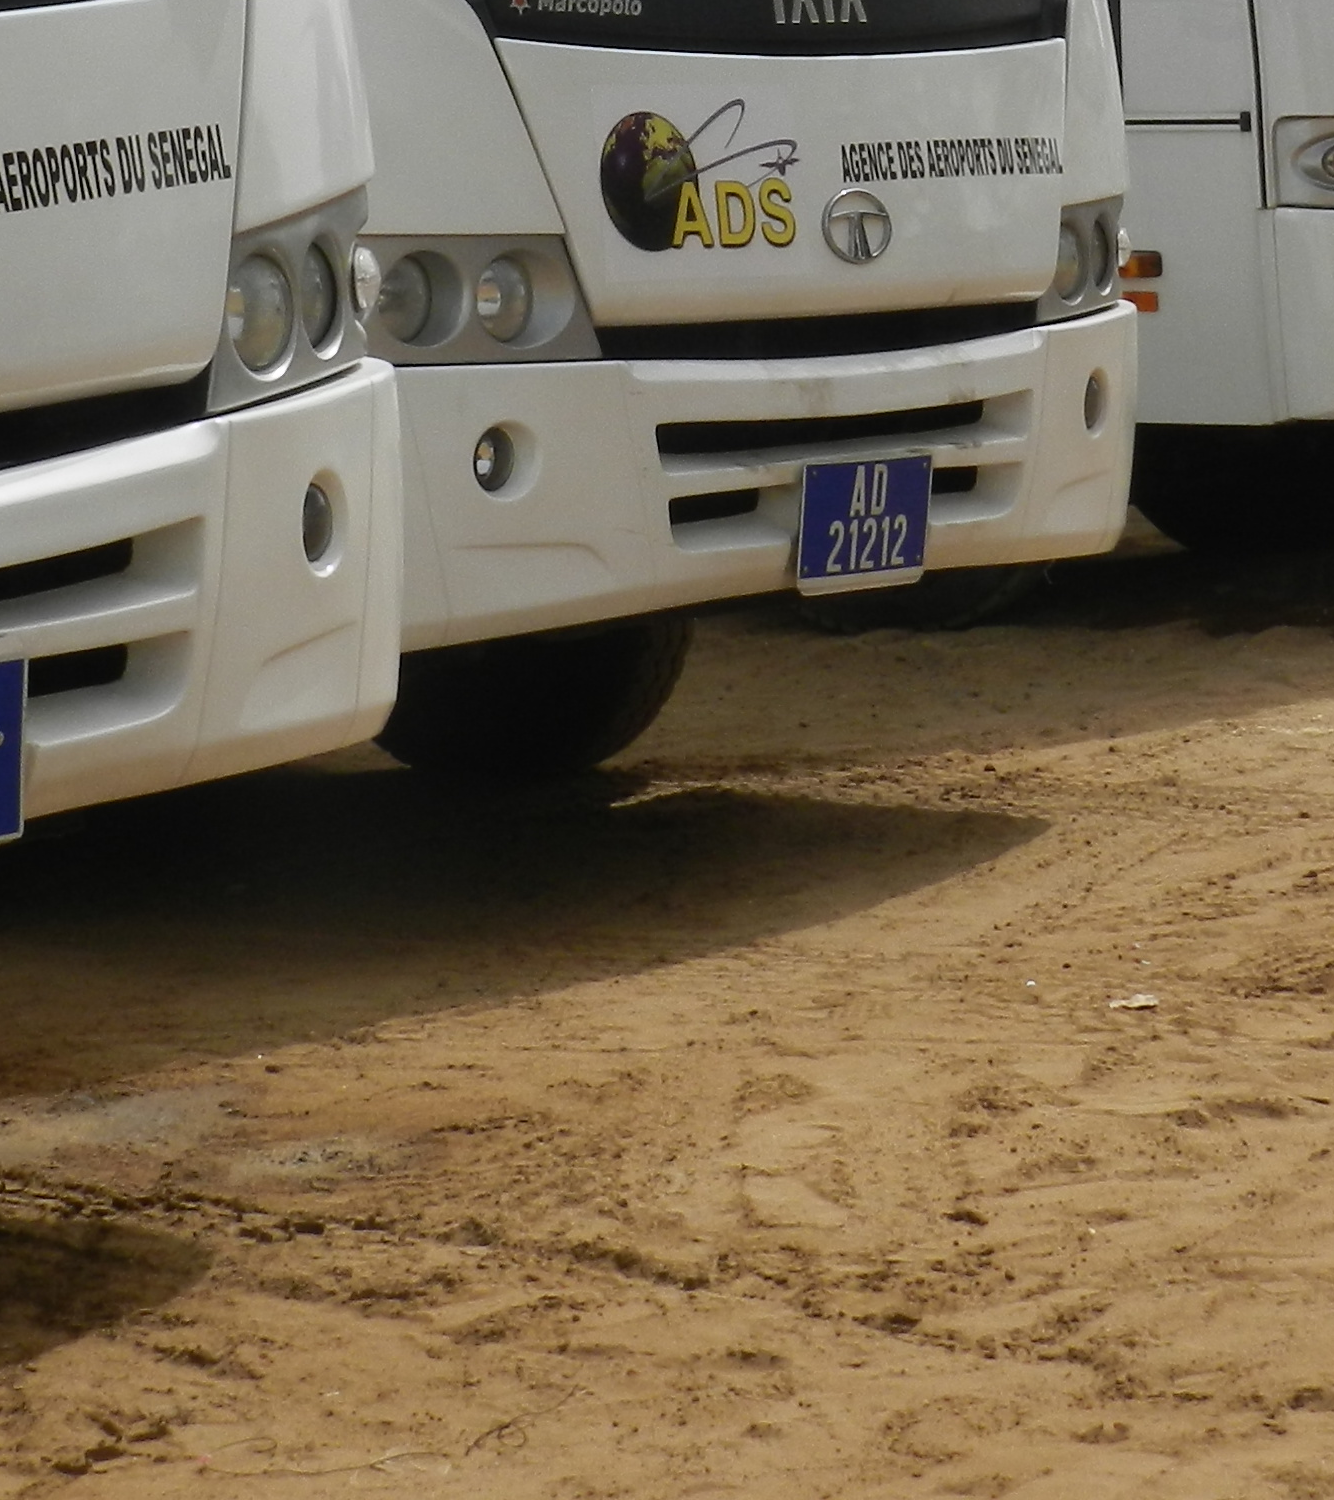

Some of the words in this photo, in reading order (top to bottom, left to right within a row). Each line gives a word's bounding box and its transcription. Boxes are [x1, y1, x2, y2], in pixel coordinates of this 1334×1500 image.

[114, 133, 147, 195] DU
[147, 123, 233, 190] SENEGAL
[841, 141, 898, 183] AGENCE
[896, 140, 925, 180] DES
[926, 137, 998, 178] AEROPORTS
[995, 137, 1015, 175] DU
[1014, 137, 1064, 175] SENEGAL
[671, 176, 797, 249] ADS
[849, 463, 889, 518] AD
[825, 513, 908, 573] 21212
